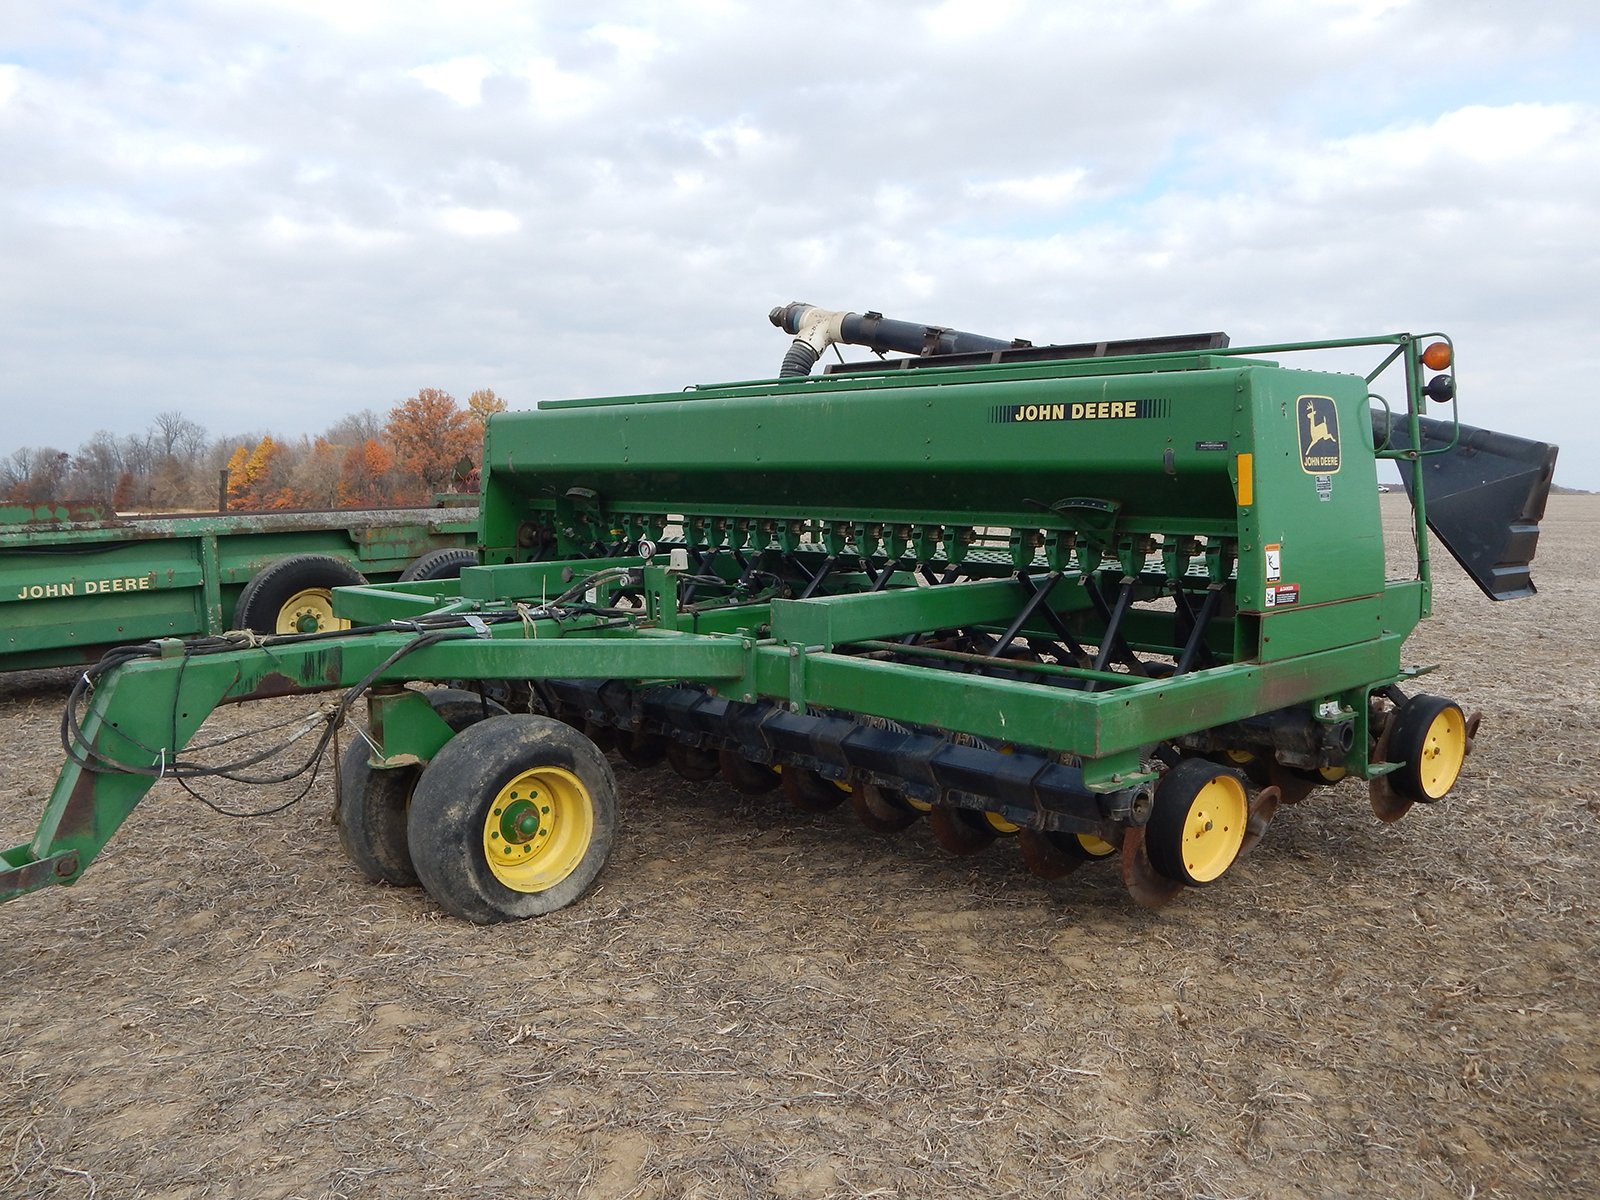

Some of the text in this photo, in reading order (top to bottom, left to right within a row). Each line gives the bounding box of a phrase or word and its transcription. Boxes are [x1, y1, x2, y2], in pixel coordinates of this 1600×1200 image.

[1015, 401, 1137, 421] JOHN DEERE
[1304, 456, 1338, 466] JOHN DEERE
[18, 577, 149, 599] JOHN DEERE
